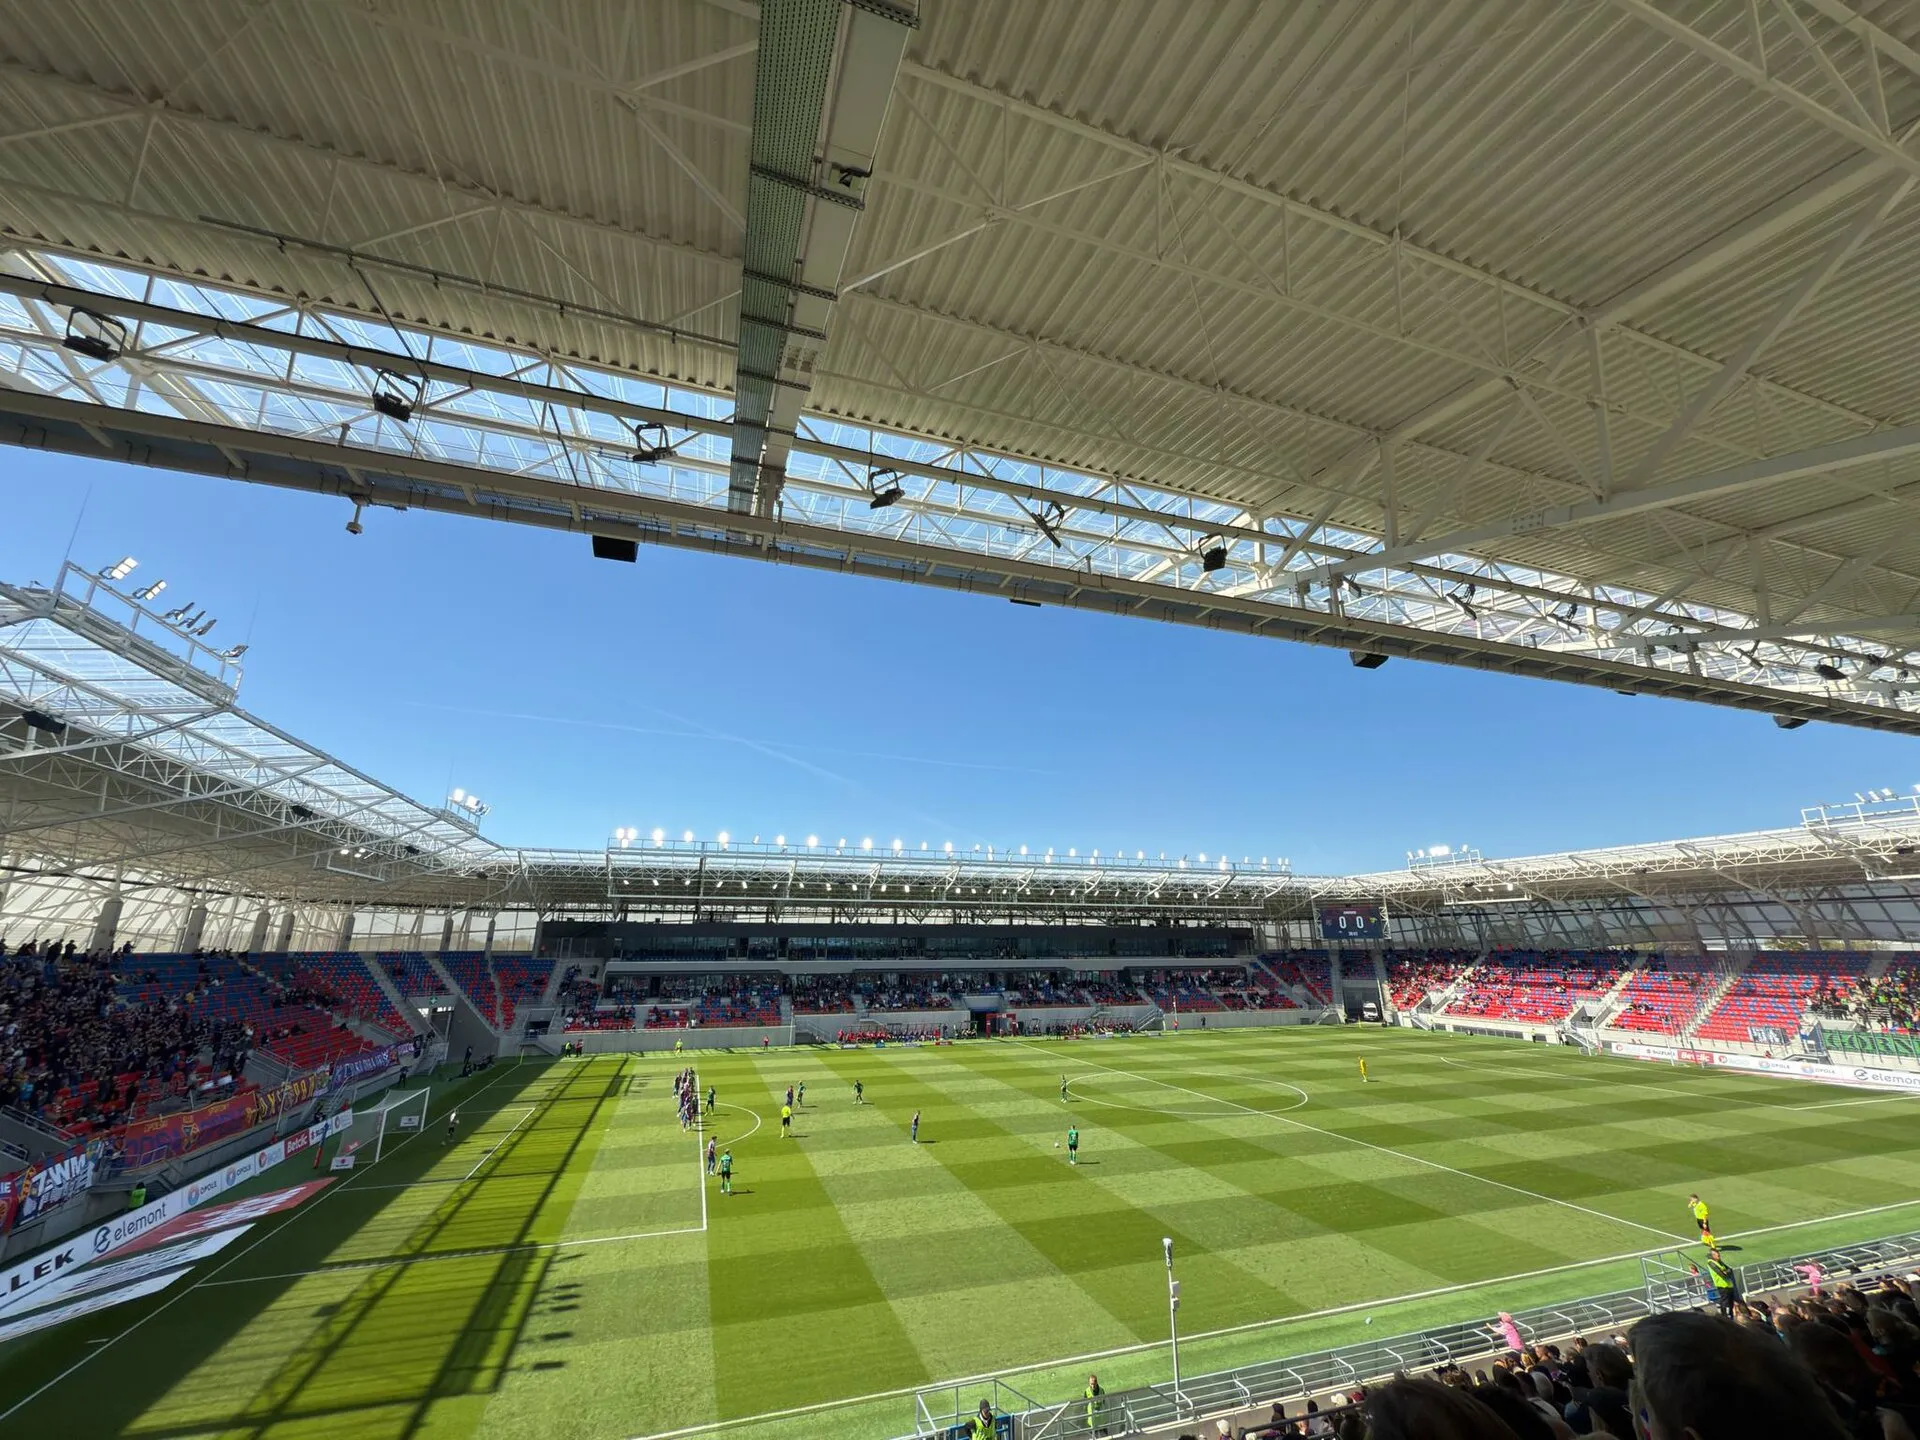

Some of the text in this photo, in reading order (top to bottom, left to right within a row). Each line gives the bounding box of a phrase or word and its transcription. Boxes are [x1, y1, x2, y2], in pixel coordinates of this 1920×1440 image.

[1339, 916, 1364, 929] 0 0
[114, 1202, 167, 1241] elemont
[0, 1248, 74, 1298] LEK
